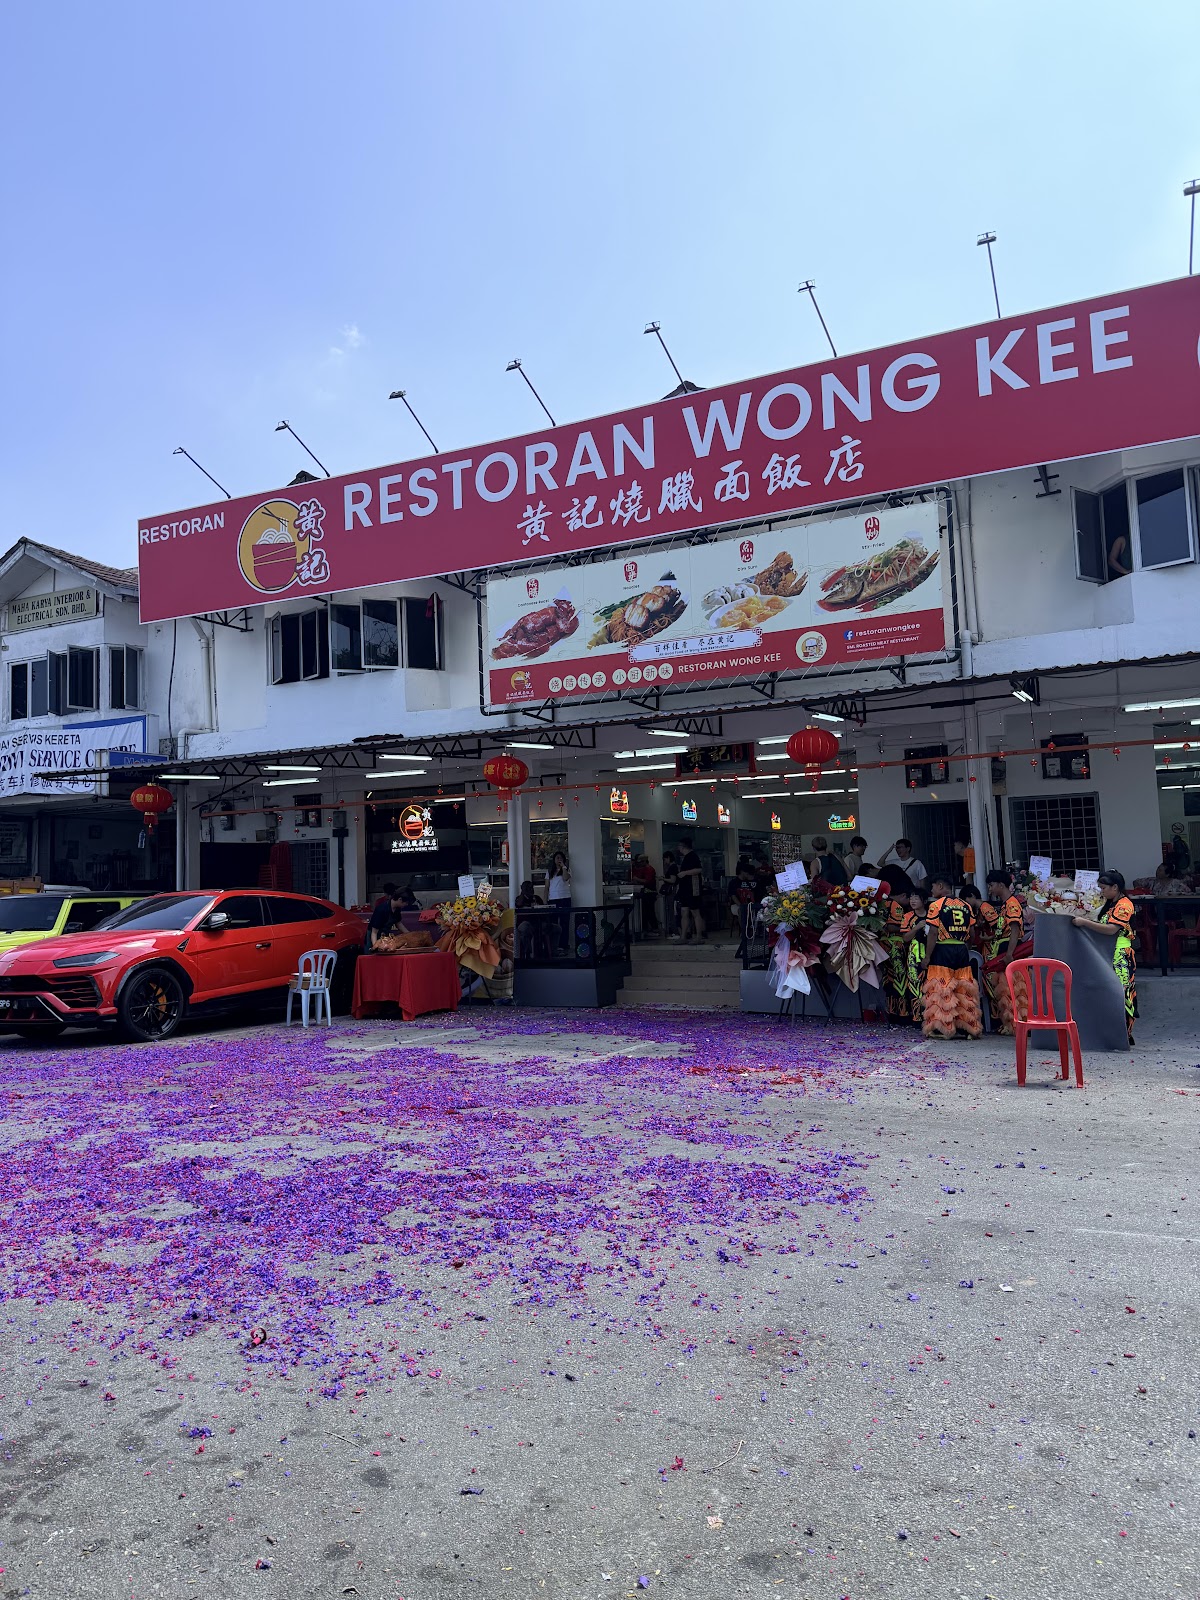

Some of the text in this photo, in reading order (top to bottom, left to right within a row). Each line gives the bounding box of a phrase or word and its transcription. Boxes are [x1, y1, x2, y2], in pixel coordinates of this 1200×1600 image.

[344, 305, 1134, 531] RESTORAN WONG KEE
[139, 512, 225, 545] RESTORAN
[12, 589, 91, 614] MAHA KARYA INTERIOR &
[17, 609, 53, 625] ELECTRICAL
[56, 607, 70, 618] SDN.
[72, 603, 87, 615] BHD.
[856, 623, 921, 637] restoranwongkee
[678, 652, 781, 674] RESTORAN WONG KEE
[45, 734, 81, 745] KERETA
